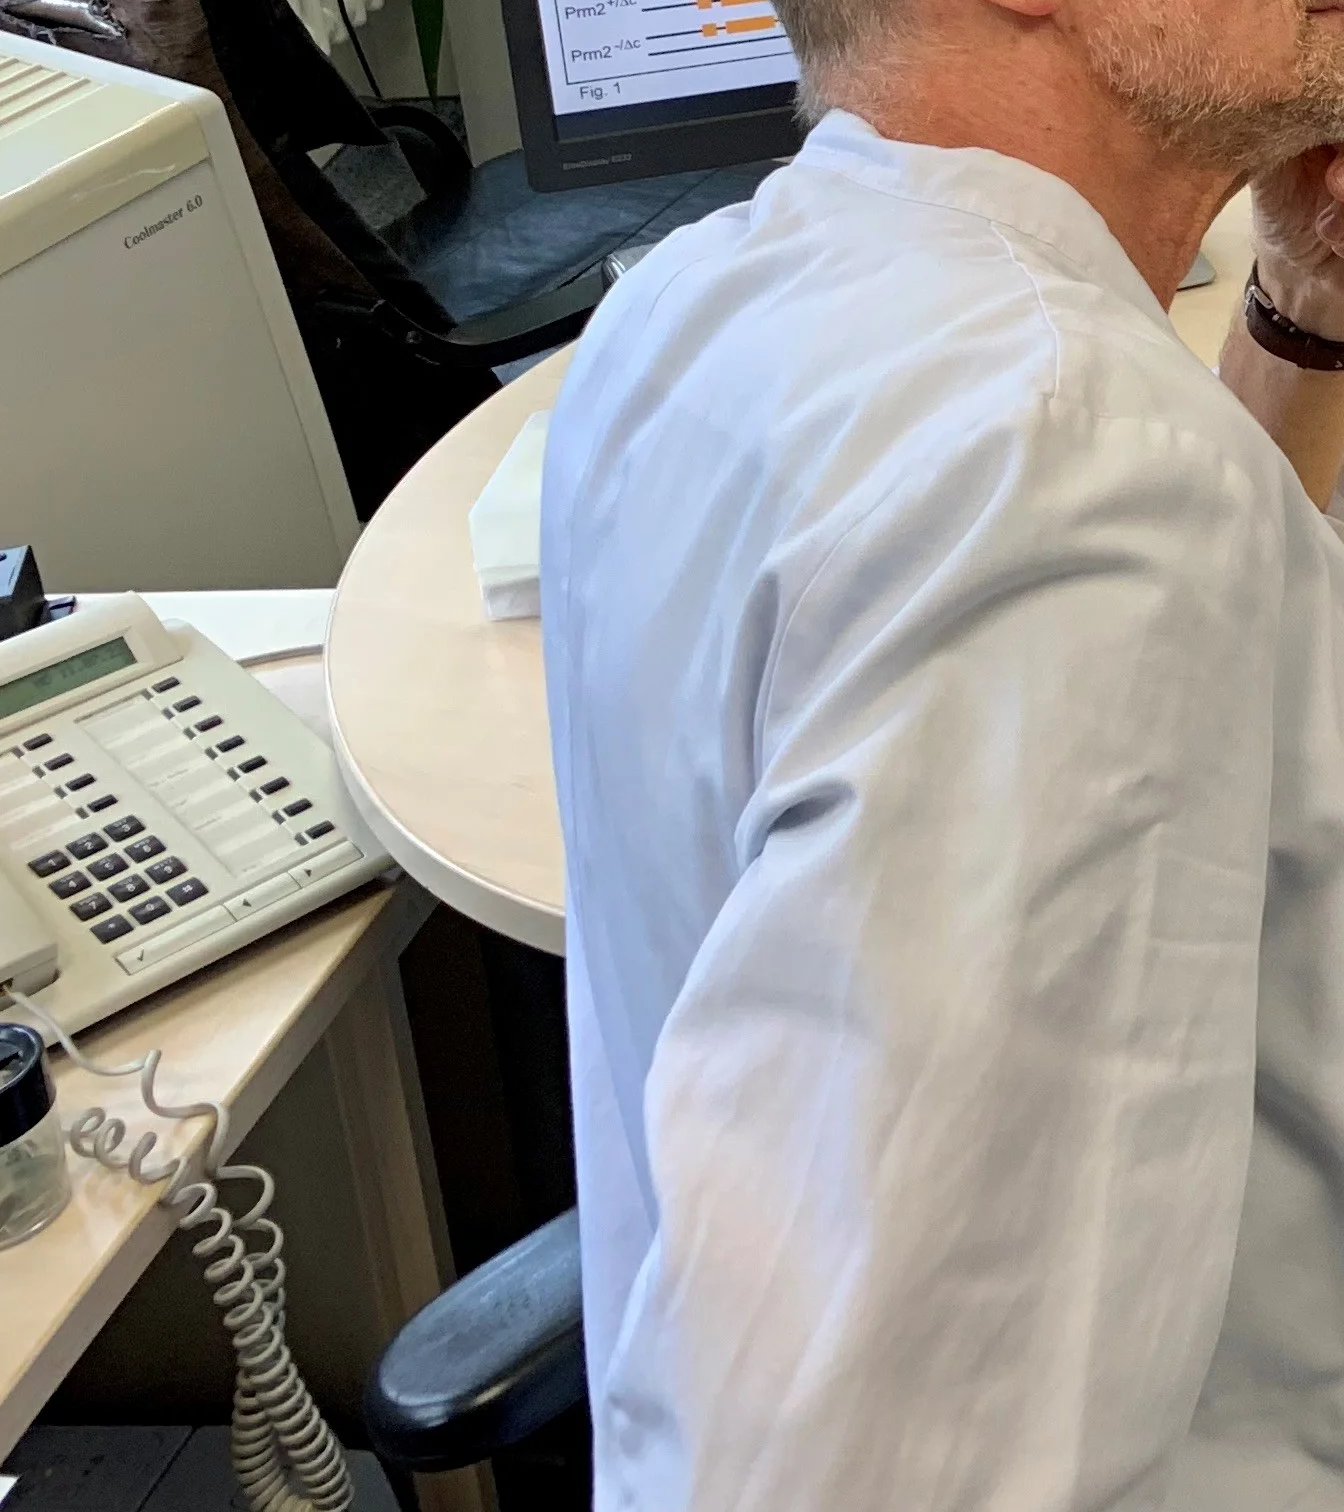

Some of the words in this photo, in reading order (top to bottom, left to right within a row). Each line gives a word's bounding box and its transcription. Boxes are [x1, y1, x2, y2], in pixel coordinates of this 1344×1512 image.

[579, 85, 609, 100] Fig.
[614, 82, 621, 94] 1
[124, 207, 183, 249] Coolmaster
[186, 194, 203, 212] 6.0
